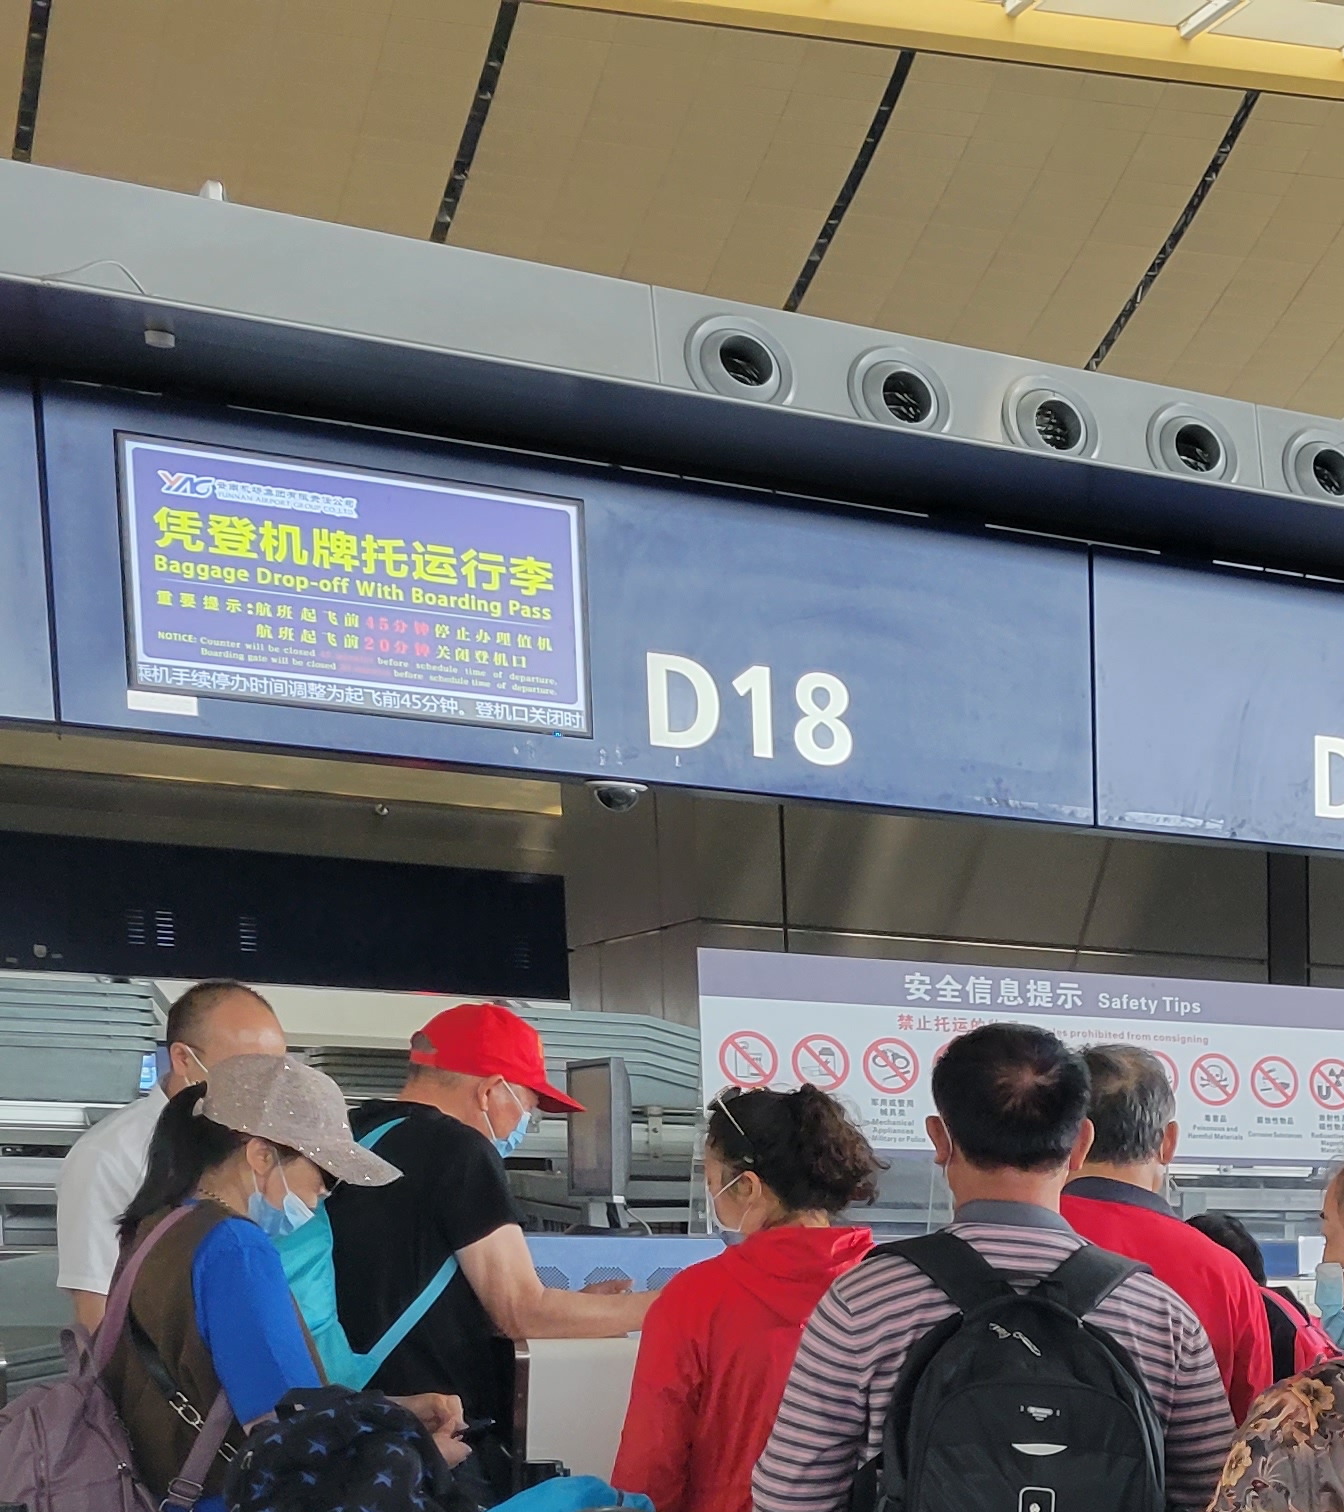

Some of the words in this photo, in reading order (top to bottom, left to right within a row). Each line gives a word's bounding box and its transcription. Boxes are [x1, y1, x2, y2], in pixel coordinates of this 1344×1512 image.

[153, 506, 554, 597] 凭登机牌托运行李
[155, 554, 250, 583] Baggage
[257, 566, 350, 593] Drop-off
[356, 579, 404, 601] With
[412, 587, 502, 618] Boarding
[509, 600, 552, 620] Pass
[200, 637, 241, 649] Counter
[245, 641, 265, 651] will
[283, 646, 316, 657] closed
[378, 657, 409, 668] before
[416, 662, 458, 674] schedule
[465, 666, 487, 677] time
[200, 648, 244, 661] Boarding
[307, 660, 337, 670] closed
[394, 670, 424, 681] before
[429, 675, 469, 687] schedule
[646, 651, 853, 768] D18
[904, 972, 1083, 1010] 安全信息提示
[1098, 992, 1159, 1015] Safety
[1162, 996, 1201, 1016] Tips
[1070, 1028, 1125, 1041] prohibited
[1127, 1031, 1151, 1041] from
[1153, 1034, 1210, 1046] consigning
